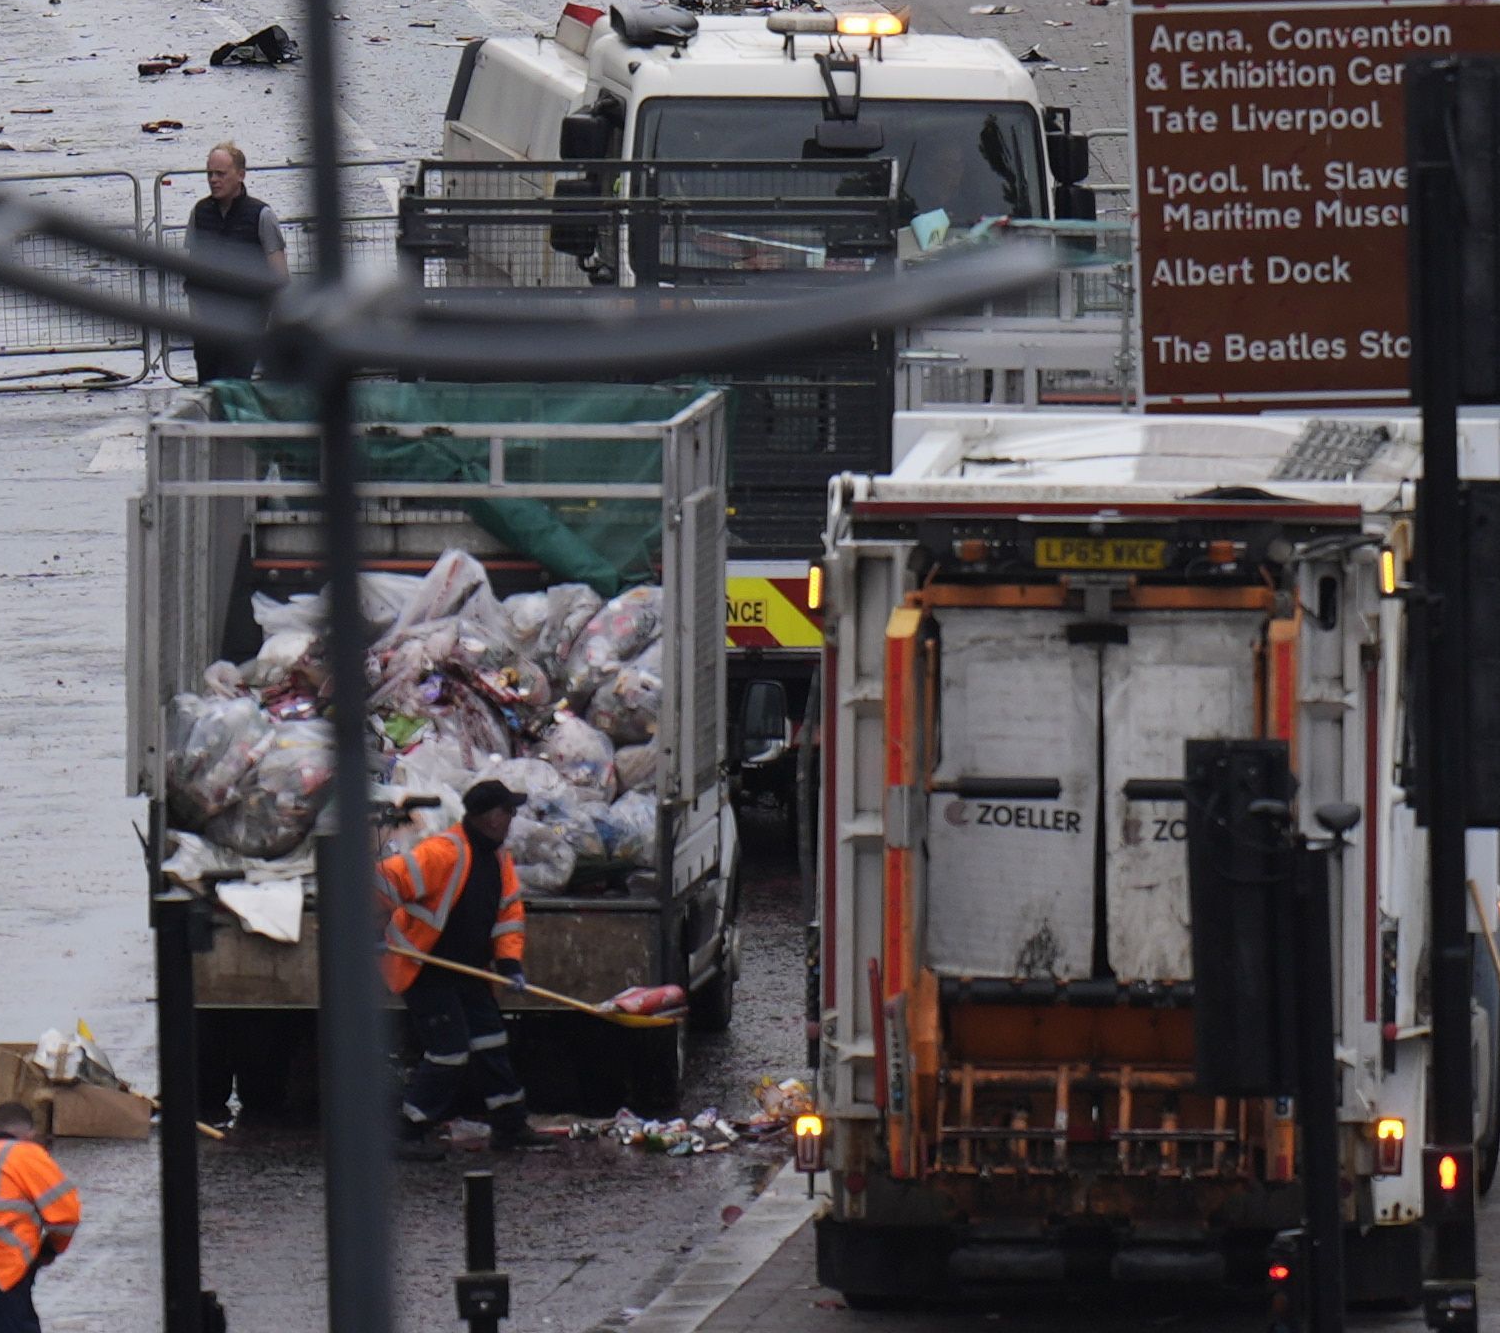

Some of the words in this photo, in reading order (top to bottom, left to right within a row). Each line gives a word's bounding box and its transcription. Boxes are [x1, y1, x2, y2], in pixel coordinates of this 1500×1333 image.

[1150, 25, 1253, 54] Arena,
[1268, 19, 1452, 50] Convention
[1145, 64, 1168, 90] &
[1181, 59, 1335, 90] Exhibition
[1146, 105, 1218, 133] Tate
[1232, 100, 1382, 135] Liverpool
[1262, 163, 1311, 192] Int.
[1325, 161, 1408, 191] Slave
[1163, 203, 1301, 231] Maritime
[1315, 200, 1408, 228] Muse
[1153, 258, 1255, 287] Albert
[1267, 255, 1352, 284] Dock
[1153, 336, 1211, 363] The
[1225, 333, 1347, 362] Beatles
[1360, 331, 1412, 359] Sto
[976, 803, 1082, 834] ZOELLER
